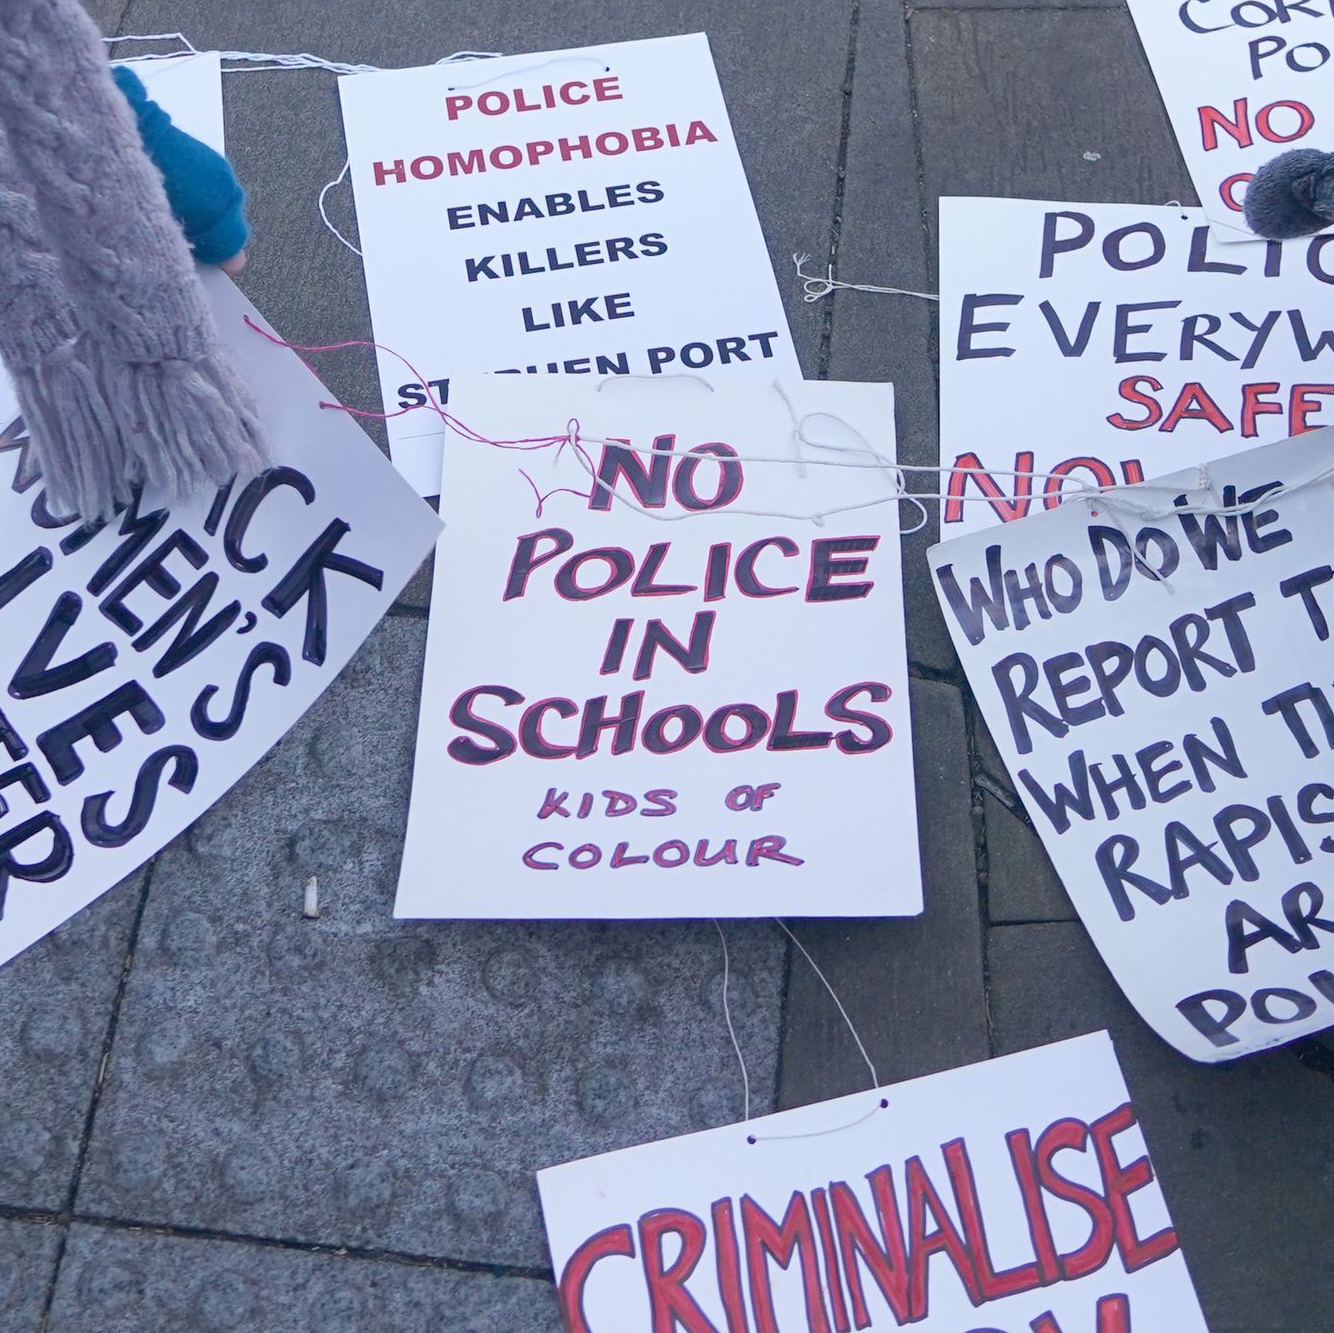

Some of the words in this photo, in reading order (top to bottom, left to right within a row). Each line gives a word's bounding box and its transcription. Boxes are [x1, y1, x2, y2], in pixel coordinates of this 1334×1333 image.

[445, 76, 624, 121] POLICE
[1197, 97, 1315, 152] NO
[372, 120, 718, 186] HOMOPHOBIA
[447, 180, 665, 230] ENABLES
[465, 232, 669, 283] KILLERS
[522, 292, 635, 332] LIKE
[646, 331, 779, 375] PORT
[588, 433, 744, 511] NO
[503, 527, 880, 603] POLICE
[935, 544, 1083, 647] WHO
[1088, 524, 1175, 602] DO
[1173, 481, 1293, 571] WE
[599, 611, 716, 680] IN
[991, 592, 1258, 755] REPORT
[447, 681, 892, 765] SCHOOLS
[537, 787, 679, 818] KIDS
[725, 783, 782, 811] OF
[1017, 715, 1248, 836] WHEN
[522, 834, 805, 870] COLOUR
[558, 1101, 1180, 1333] CRIMINALISE
